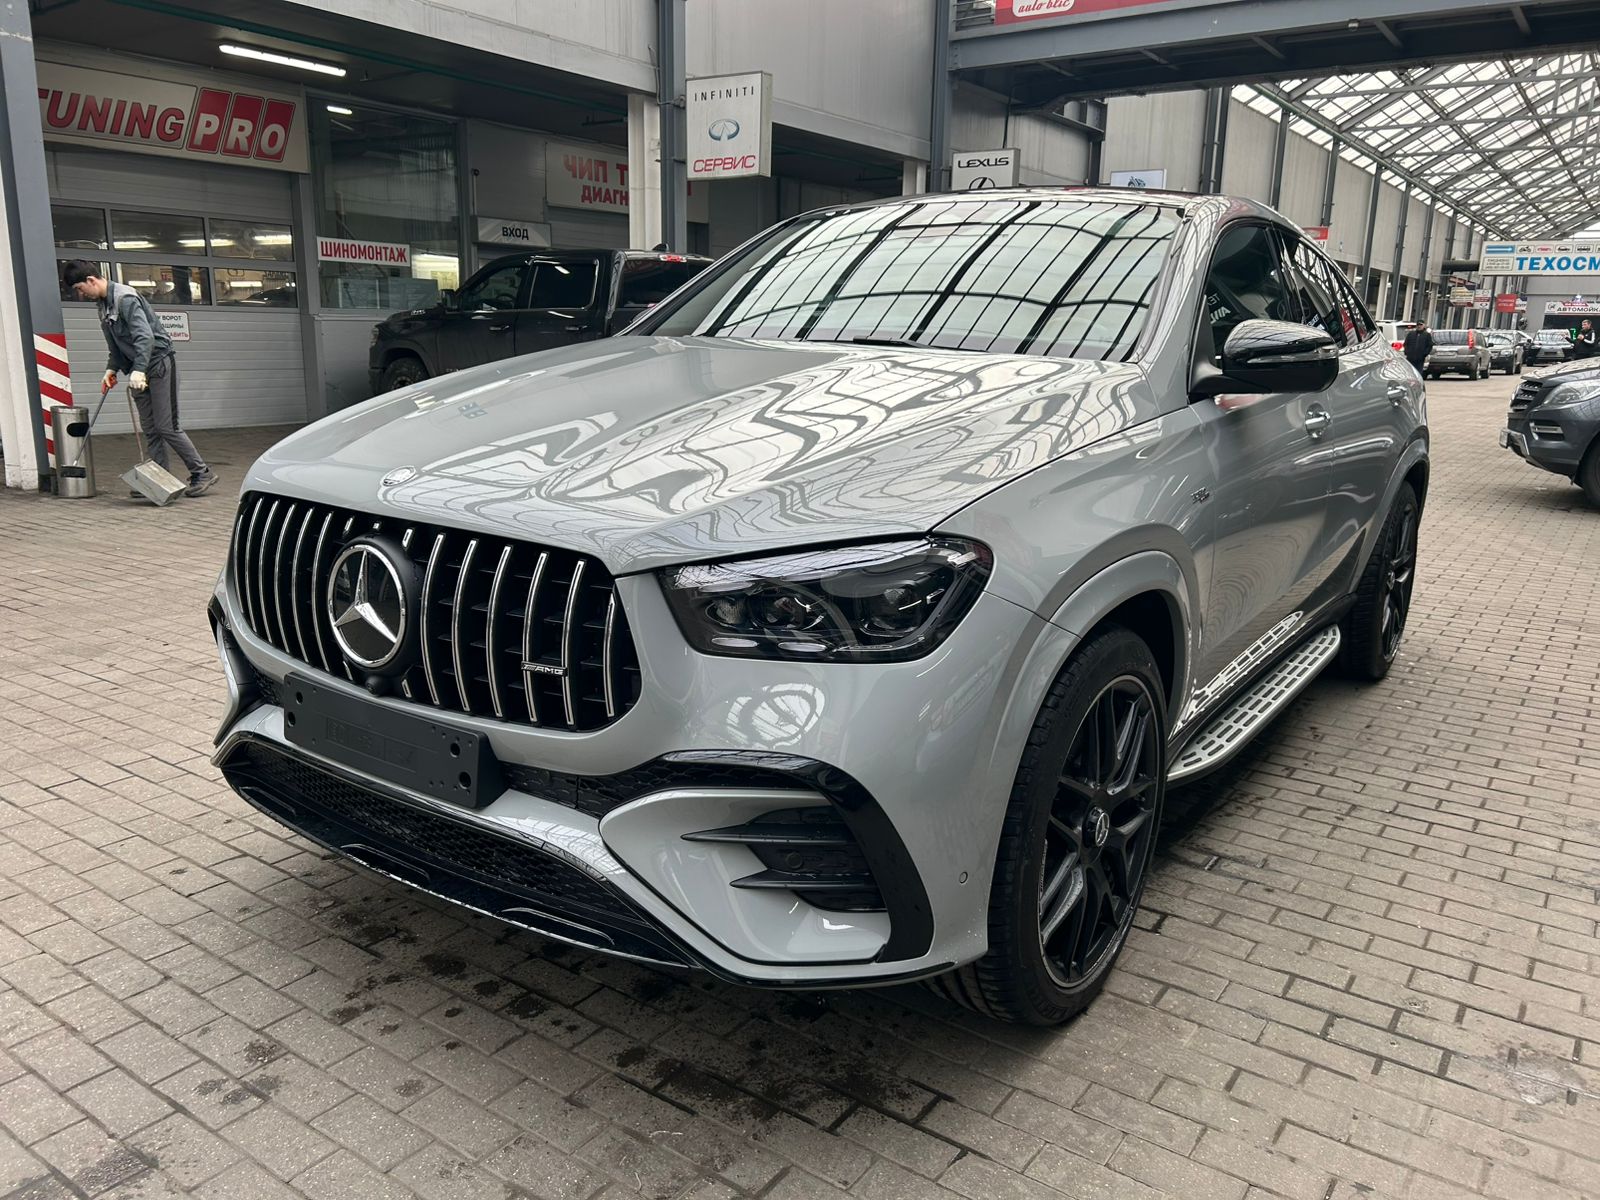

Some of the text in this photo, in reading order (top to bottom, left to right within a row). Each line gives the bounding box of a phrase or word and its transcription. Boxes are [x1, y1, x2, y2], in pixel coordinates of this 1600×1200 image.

[694, 86, 755, 102] INFINITI
[193, 113, 287, 157] PRO
[563, 154, 608, 184] ЧИП
[693, 155, 756, 173] СЕРВИС
[957, 156, 1010, 169] LEXUS
[502, 226, 530, 241] ВХОД
[320, 240, 408, 263] ШИНОМОНТАЖ
[1516, 256, 1600, 271] ТЕХОСМ
[535, 666, 563, 675] AMG
